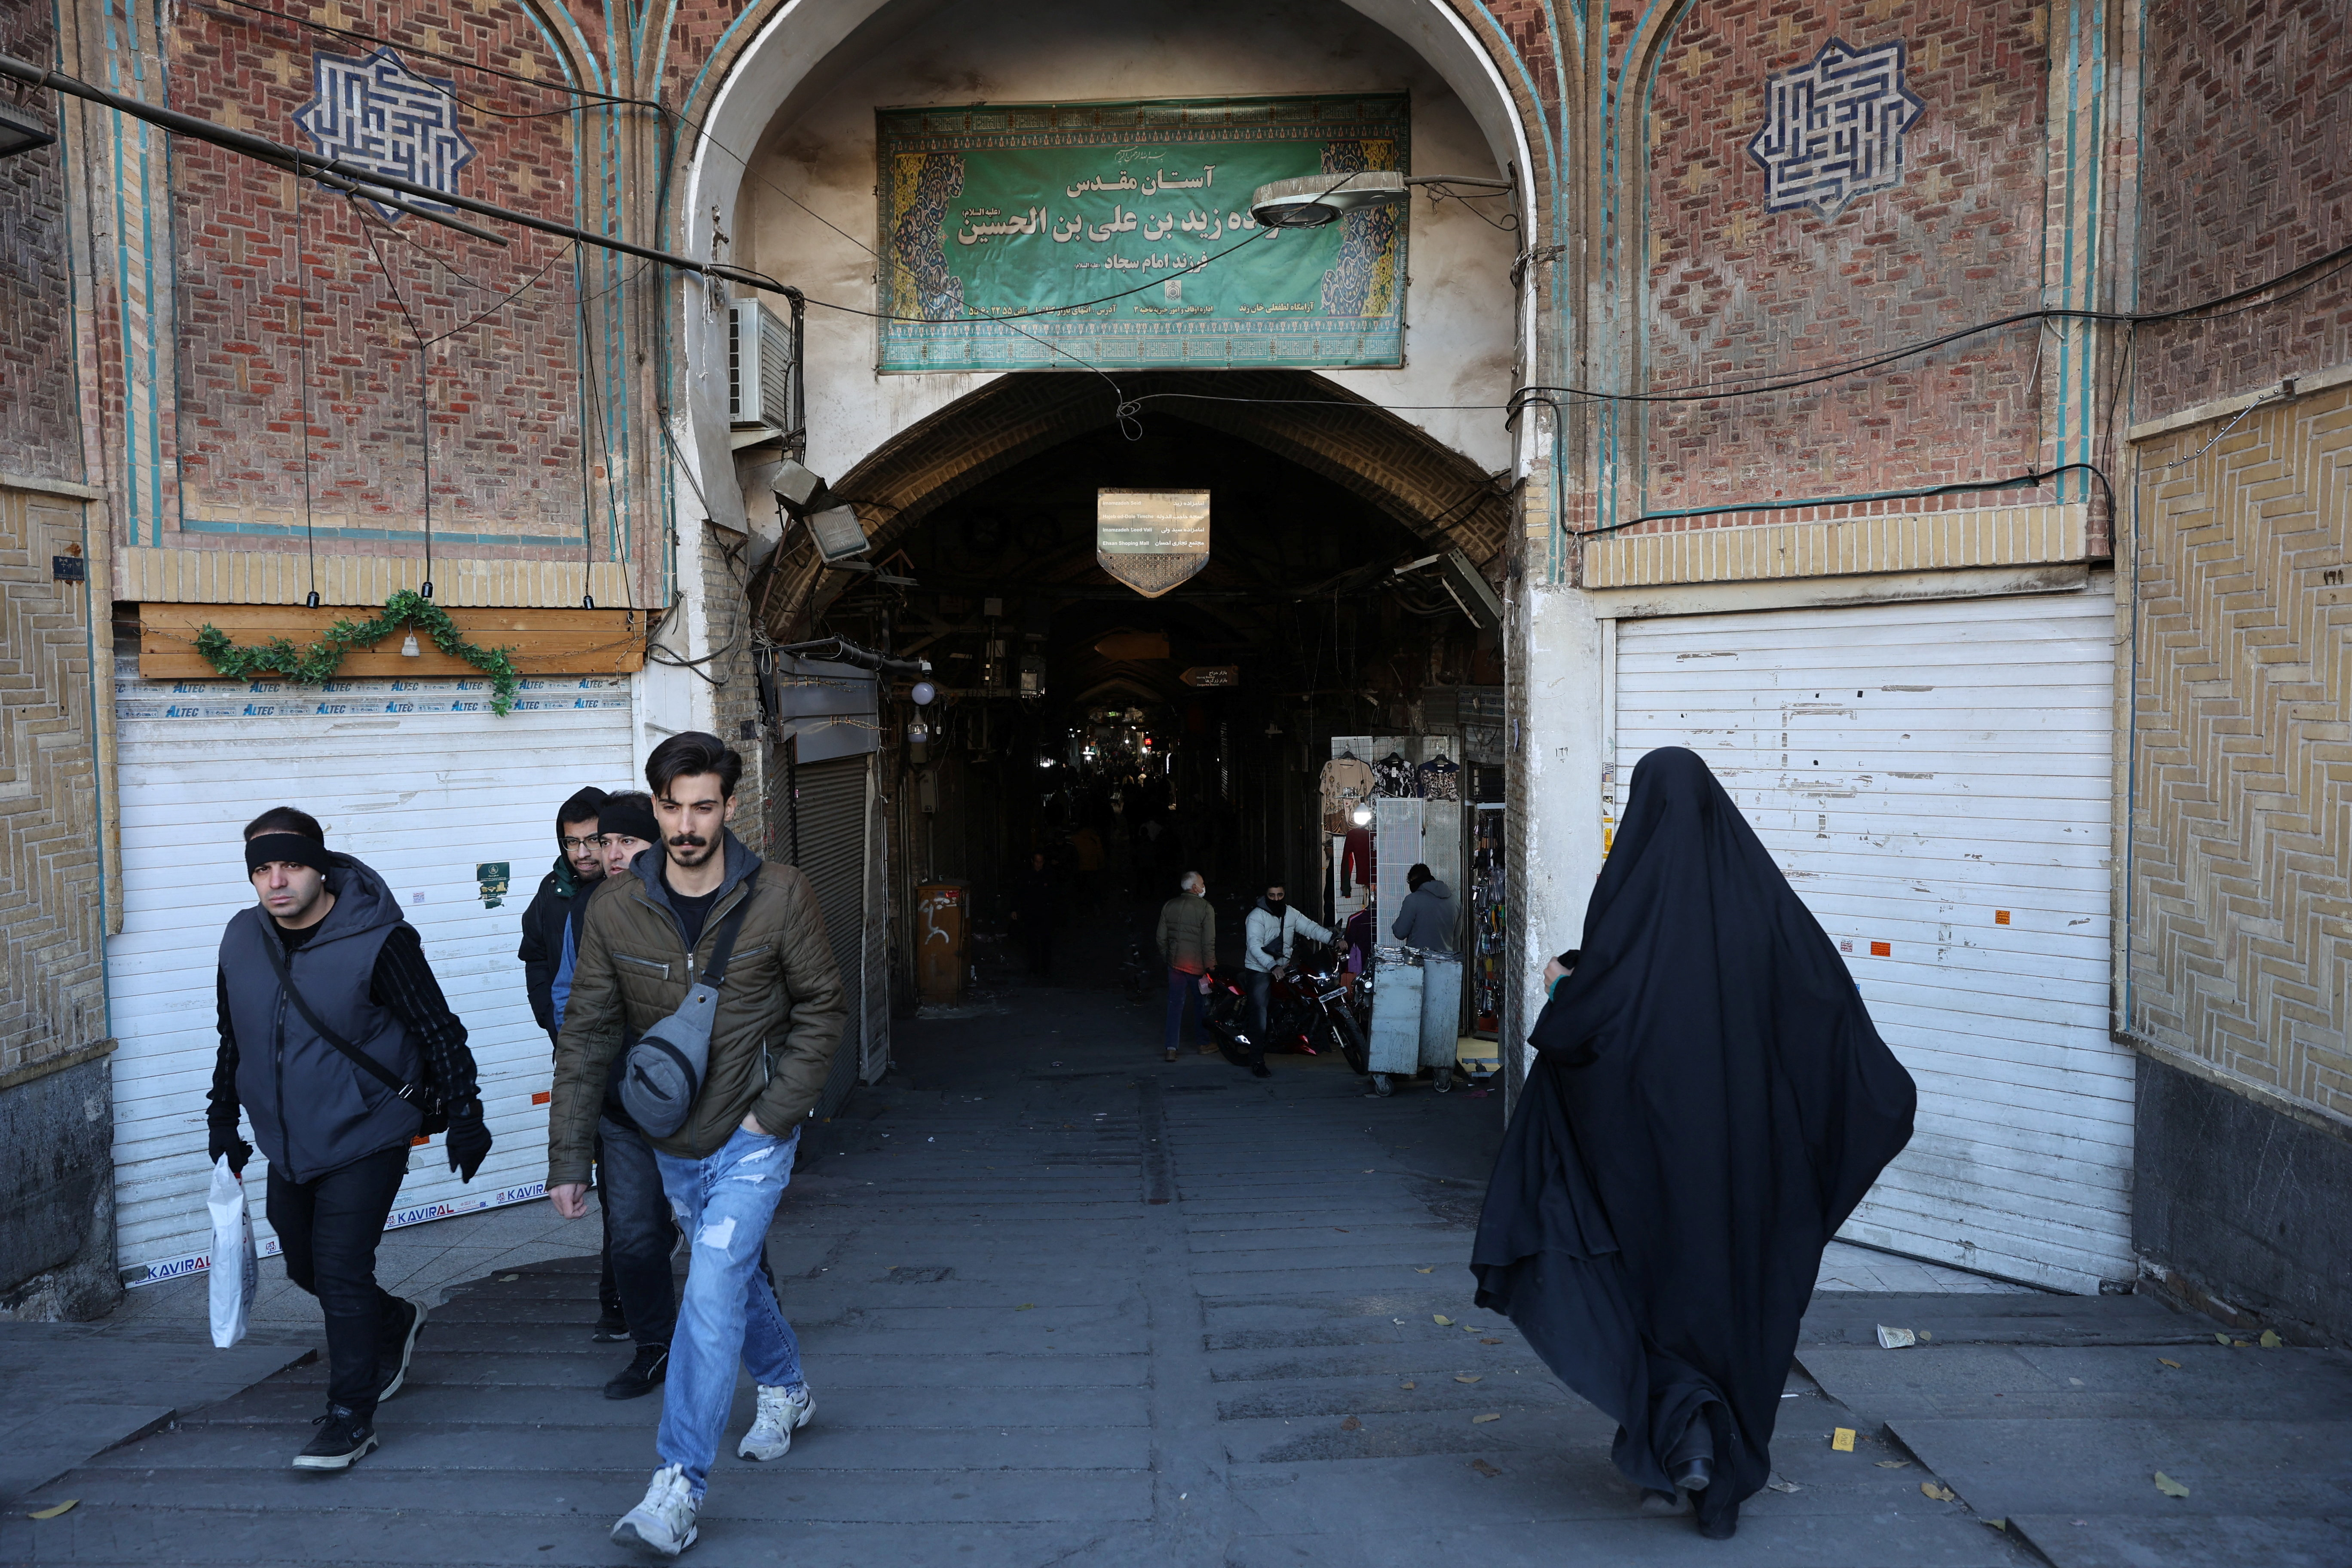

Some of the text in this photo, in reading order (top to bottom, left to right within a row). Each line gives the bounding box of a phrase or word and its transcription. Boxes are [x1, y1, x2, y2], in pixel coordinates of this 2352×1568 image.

[1066, 164, 1216, 198] آستان مقدس
[957, 205, 1047, 245] الحسین
[1051, 213, 1083, 242] بن
[1087, 204, 1138, 242] علی
[1142, 211, 1174, 242] بن
[1180, 208, 1222, 240] زید
[1104, 251, 1209, 274] فرزند امام سجاد
[991, 306, 1001, 315] ۲۲
[1002, 306, 1012, 315] ۵۵
[1014, 306, 1028, 316] تلفن
[1056, 305, 1071, 316] بازار
[1071, 305, 1092, 316] انتهای
[1096, 303, 1117, 316] آدرس
[1133, 305, 1139, 314] ۳
[1139, 306, 1154, 315] ناحیه
[1168, 306, 1180, 315] امور
[1185, 305, 1200, 314] اوقاف
[1198, 306, 1213, 314] اداره
[1238, 301, 1314, 314] آرامگاه لطفعلی خان زند
[173, 681, 205, 693] ALTEC
[249, 681, 280, 693] ALTEC
[322, 681, 352, 692] ALTEC
[391, 680, 419, 691] ALTEC
[456, 680, 483, 690] ALTEC
[519, 679, 544, 689] ALTEC
[578, 678, 603, 689] ALTEC
[165, 705, 199, 717] ALTEC
[243, 704, 274, 716] ALTEC
[316, 702, 346, 714] ALTEC
[385, 701, 413, 713] ALTEC
[451, 700, 478, 711] ALTEC
[513, 699, 539, 710] ALTEC
[573, 698, 598, 708] ALTEC
[508, 1184, 548, 1200] KAVIR
[398, 1204, 454, 1224] KAVIRAL
[148, 1256, 210, 1280] KAVIRAL
